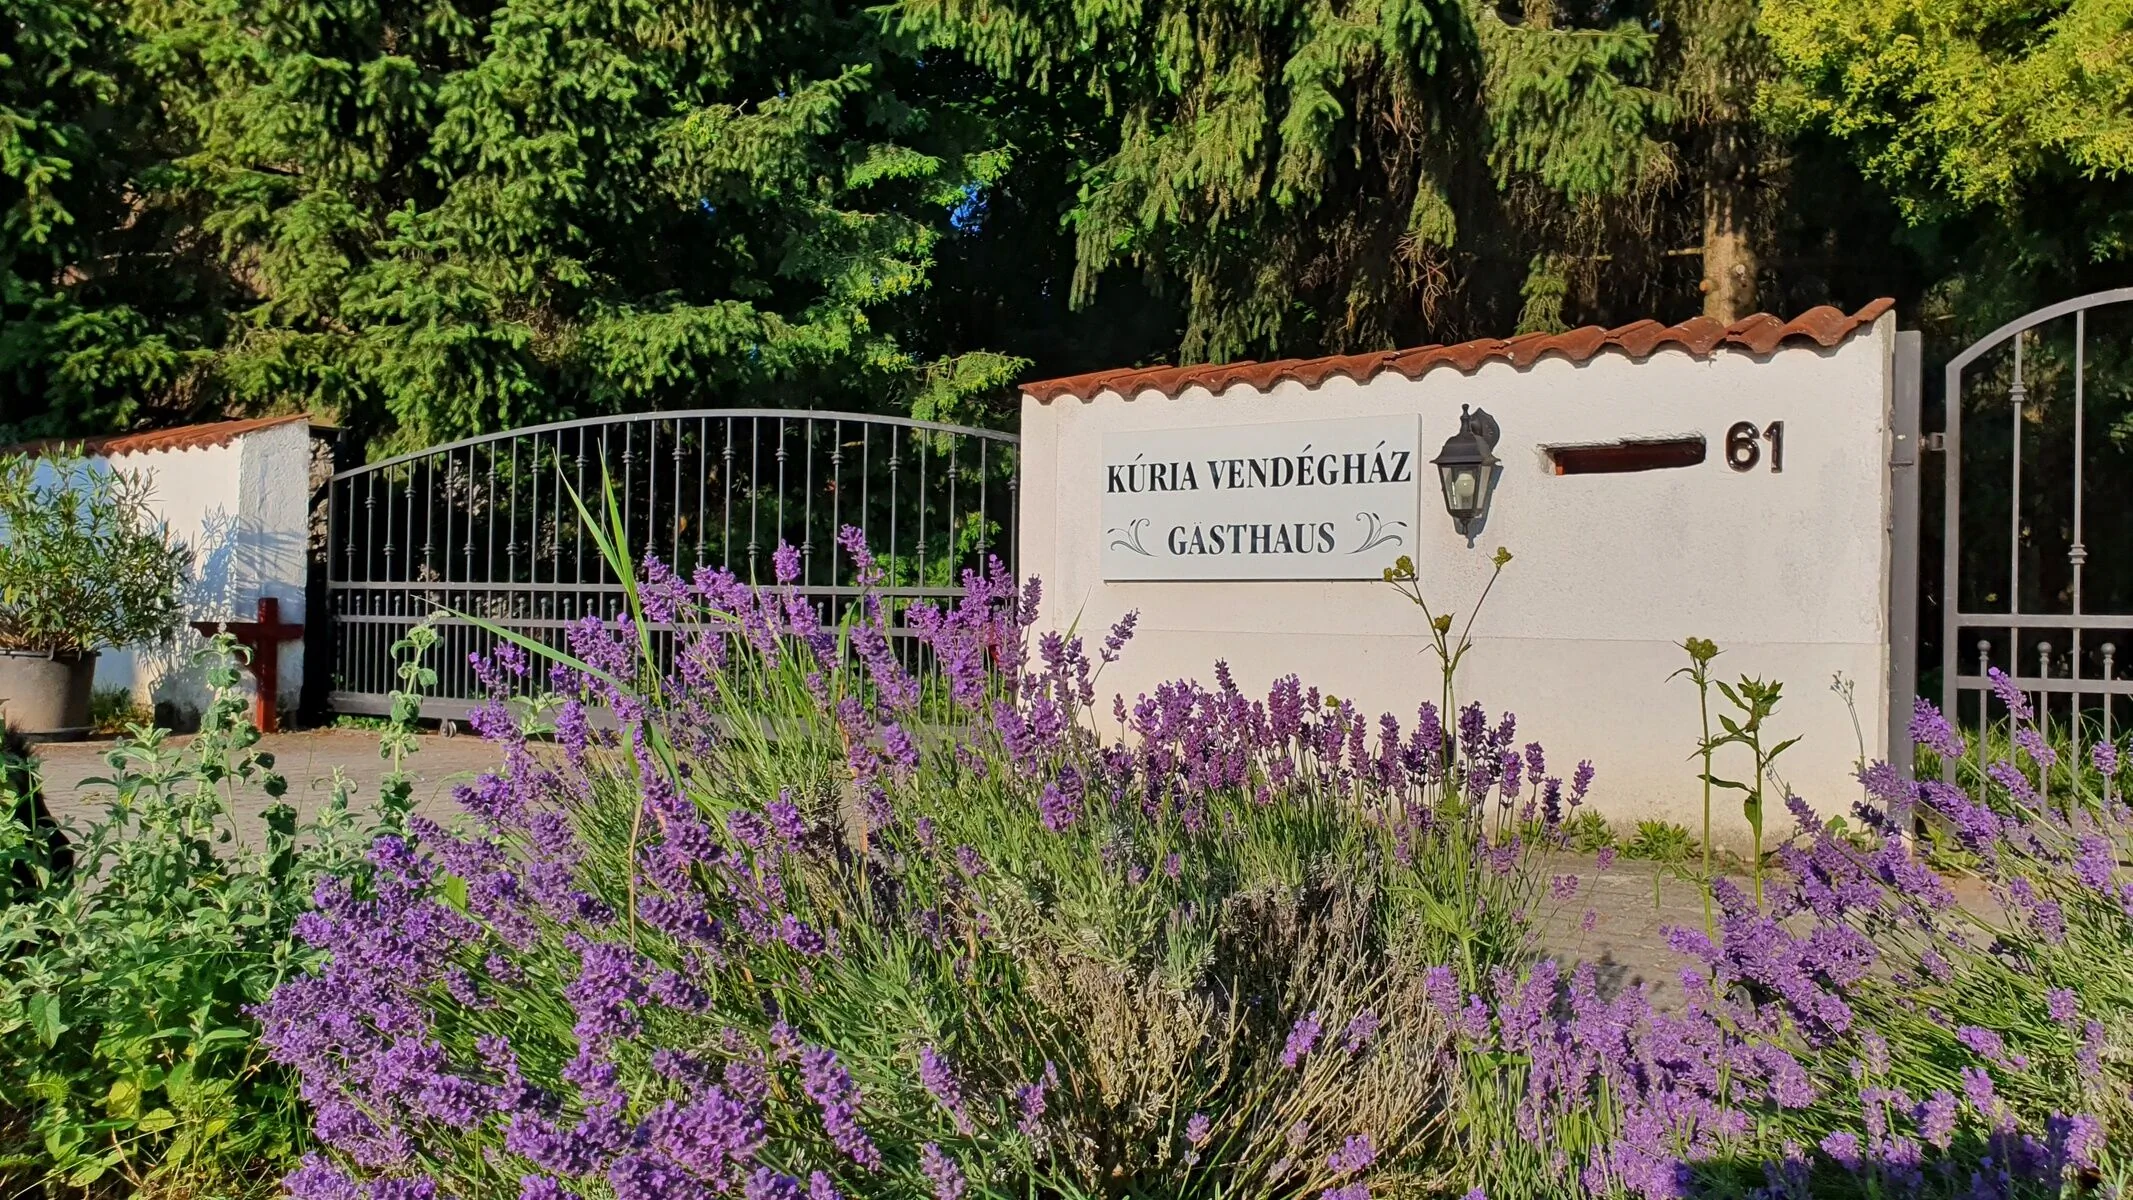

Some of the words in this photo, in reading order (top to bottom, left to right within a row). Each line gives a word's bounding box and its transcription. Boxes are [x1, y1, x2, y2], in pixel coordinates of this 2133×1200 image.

[1106, 453, 1199, 493] KÚRIA
[1207, 440, 1412, 490] VENDÉGHÁZ
[1725, 420, 1785, 474] 61
